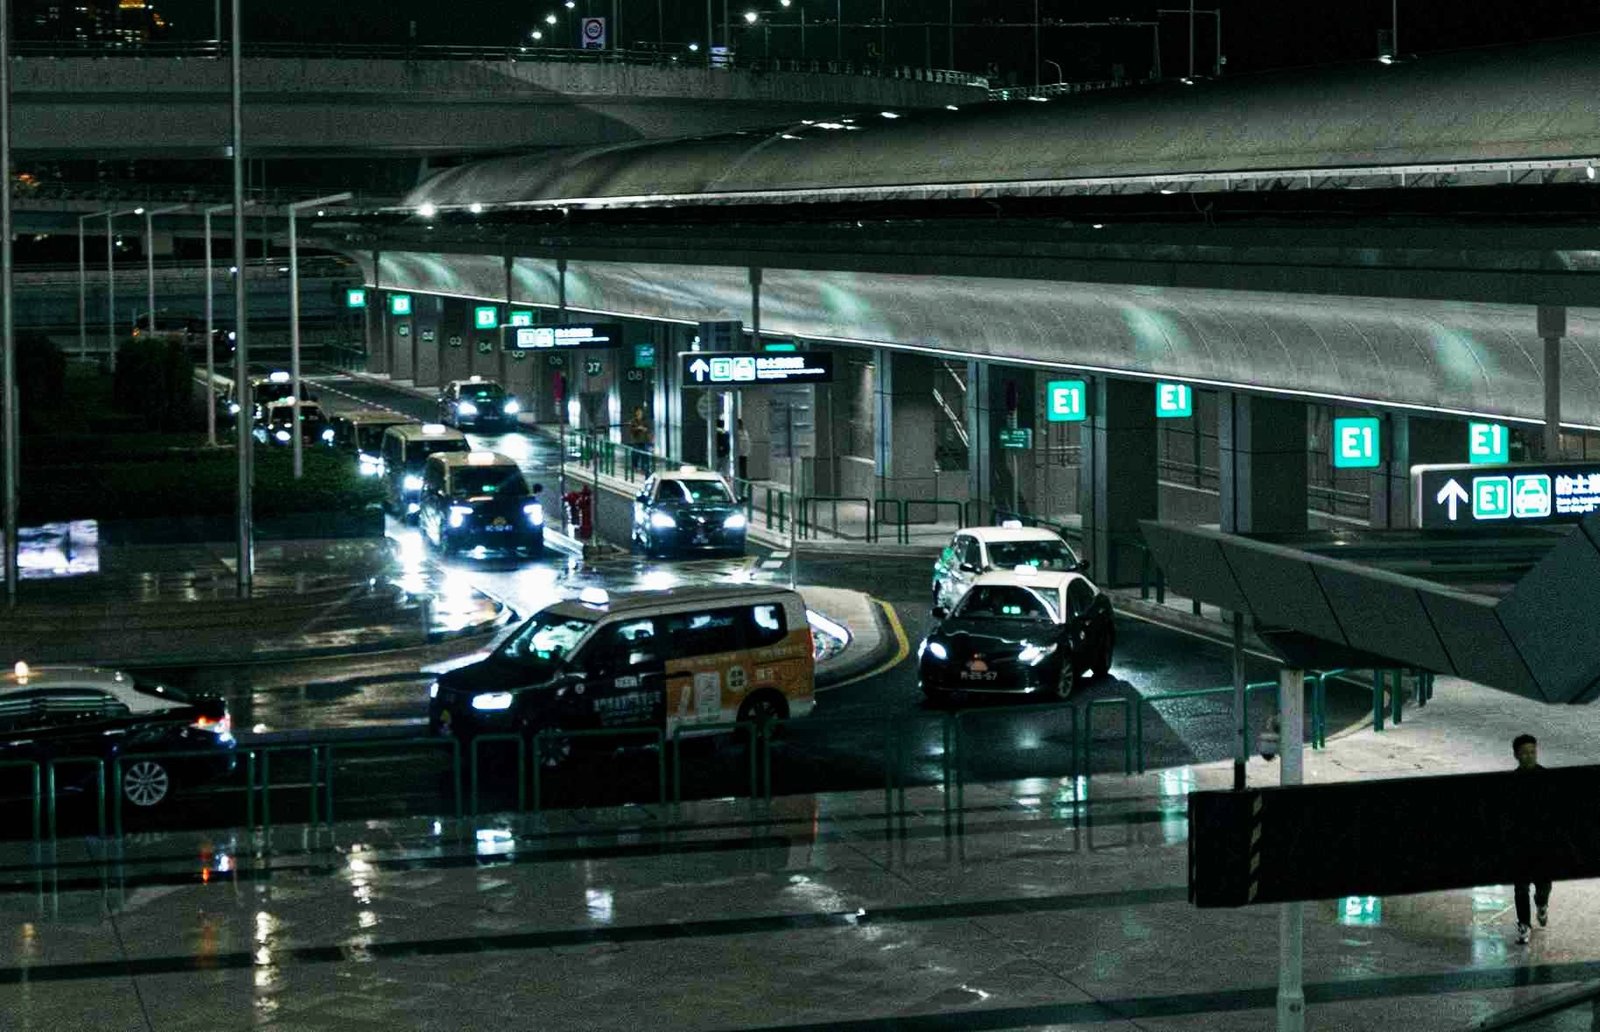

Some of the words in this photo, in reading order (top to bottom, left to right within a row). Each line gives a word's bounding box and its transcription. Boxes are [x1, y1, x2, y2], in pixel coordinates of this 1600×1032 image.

[480, 342, 492, 351] 04
[1053, 388, 1079, 414] E1
[1160, 384, 1186, 410] E1
[1342, 427, 1372, 458] E1
[1471, 424, 1501, 455] E1
[1479, 485, 1509, 514] E1
